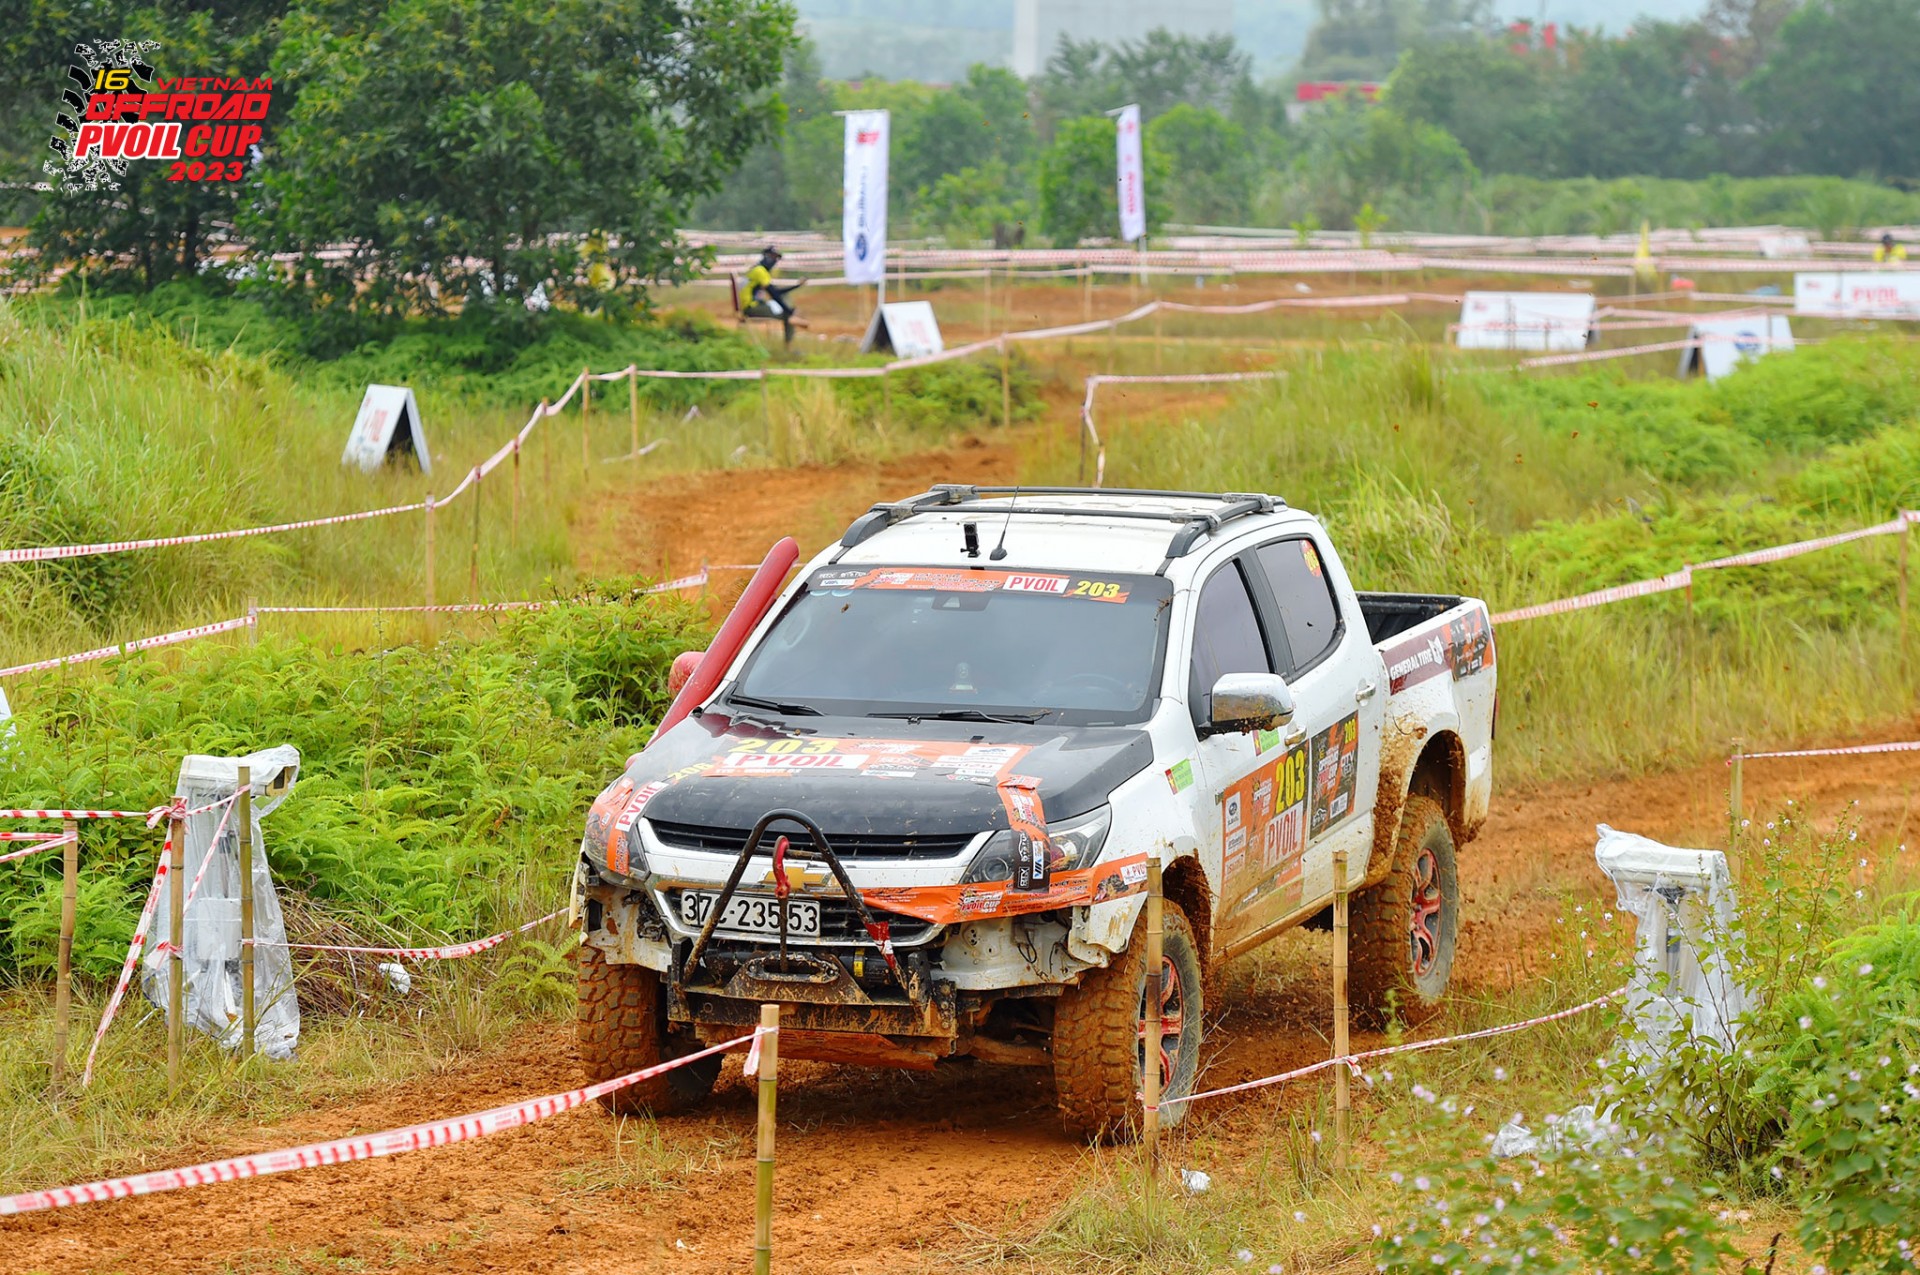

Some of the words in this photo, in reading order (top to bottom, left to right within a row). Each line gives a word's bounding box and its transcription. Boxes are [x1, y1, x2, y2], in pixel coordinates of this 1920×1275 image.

[1009, 576, 1059, 592] PVOIL
[1073, 580, 1121, 598] 203
[1390, 655, 1419, 681] GENERAL
[1416, 648, 1433, 667] TIRE
[728, 738, 840, 754] 203
[732, 754, 845, 768] PVOIL
[1275, 750, 1305, 812] 203
[618, 780, 662, 827] PVOIL
[1267, 809, 1298, 866] PVOIL
[1132, 864, 1147, 877] PVO
